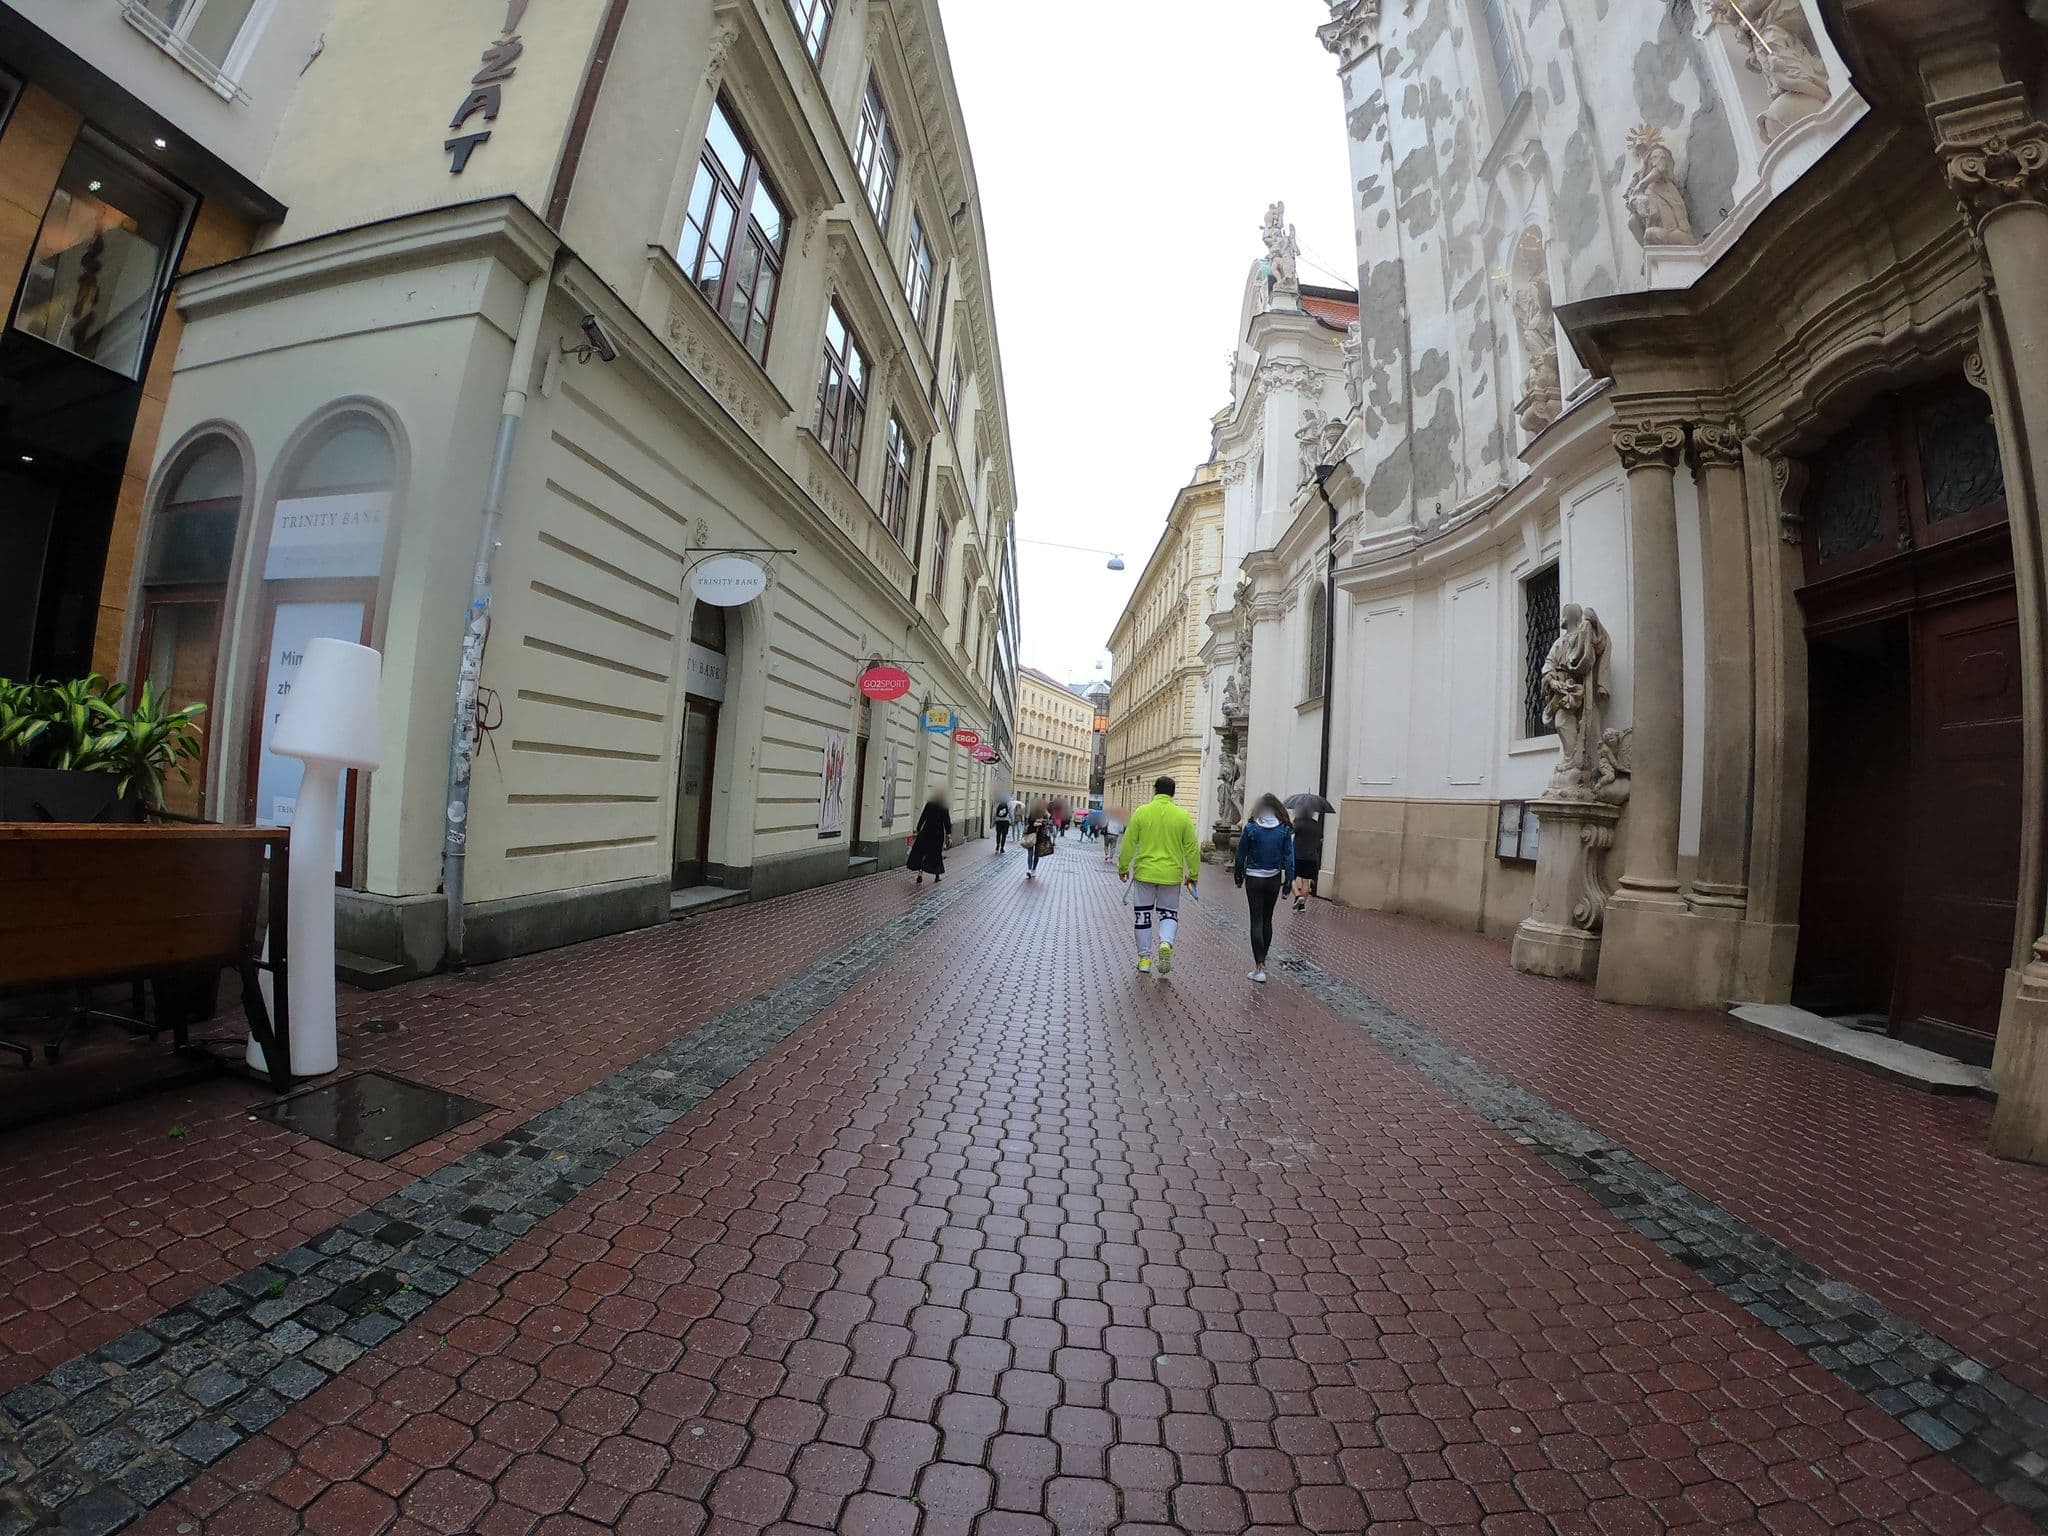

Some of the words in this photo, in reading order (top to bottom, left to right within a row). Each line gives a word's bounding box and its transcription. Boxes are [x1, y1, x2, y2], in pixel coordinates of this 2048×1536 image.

[281, 512, 338, 529] TRINITY
[698, 578, 732, 586] TRINITY
[735, 578, 759, 586] BANK
[863, 679, 907, 688] GO2SPORT
[955, 734, 978, 744] ERGO
